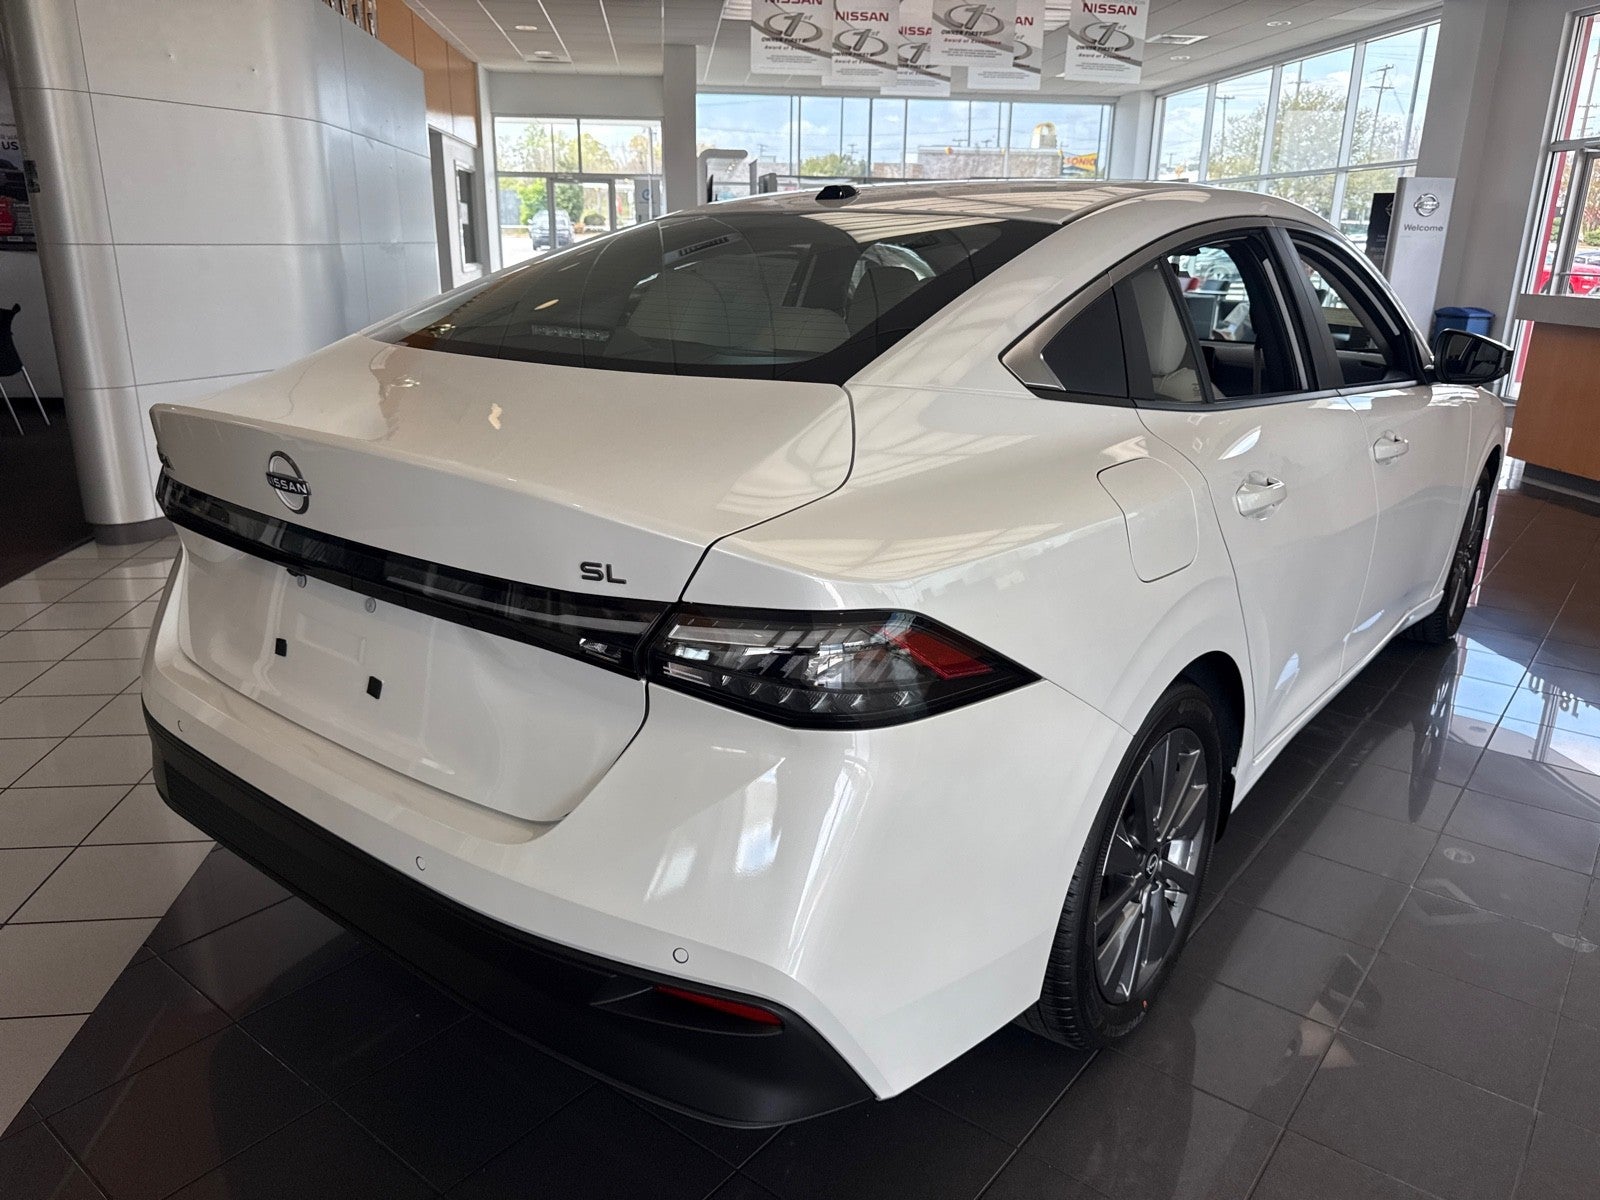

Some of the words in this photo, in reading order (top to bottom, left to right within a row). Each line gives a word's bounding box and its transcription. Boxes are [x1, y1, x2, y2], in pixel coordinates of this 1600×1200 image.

[1083, 3, 1138, 15] NISSAN
[835, 11, 889, 21] NISSAN
[1, 141, 19, 151] US
[1404, 224, 1444, 232] Welcome
[580, 561, 627, 585] SL
